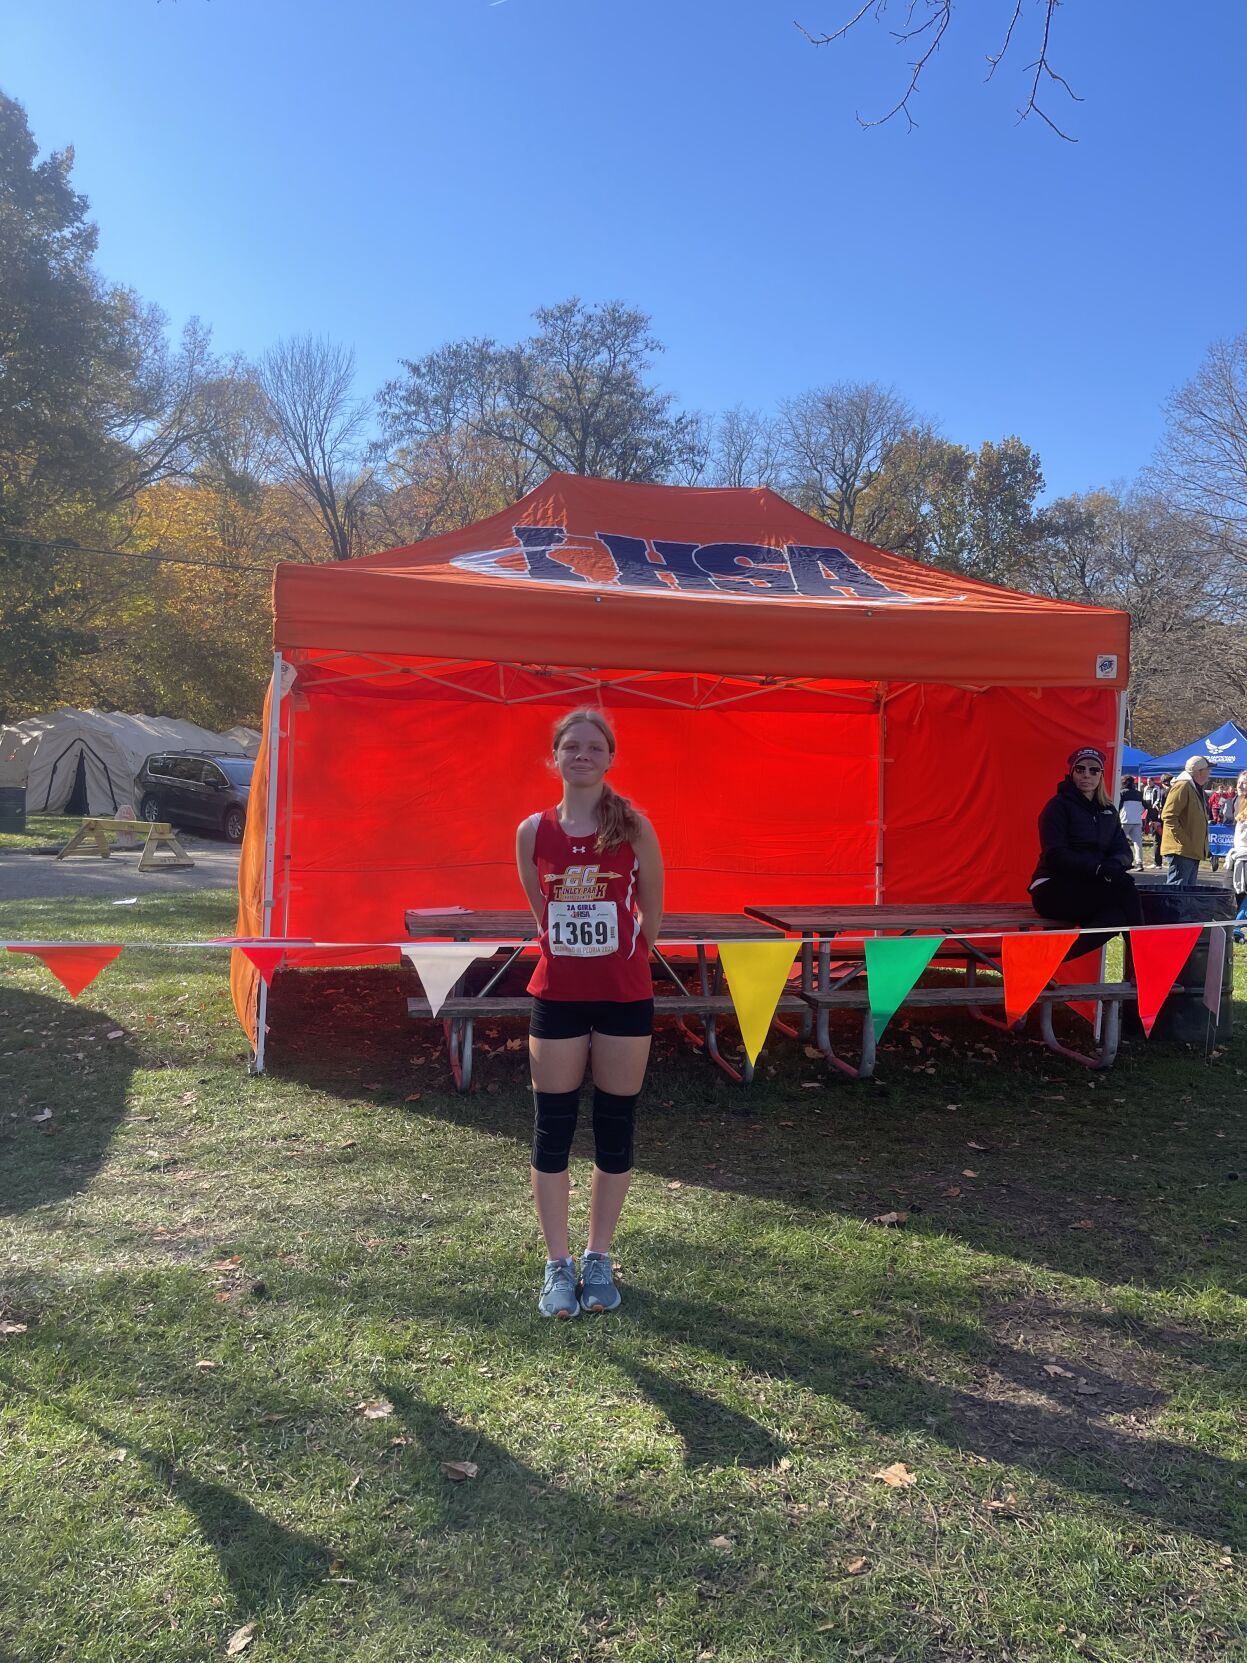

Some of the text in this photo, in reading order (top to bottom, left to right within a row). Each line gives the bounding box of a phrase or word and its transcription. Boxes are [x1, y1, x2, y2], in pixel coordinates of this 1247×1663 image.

[555, 885, 606, 899] TINLEY PARK
[552, 921, 608, 945] 1369
